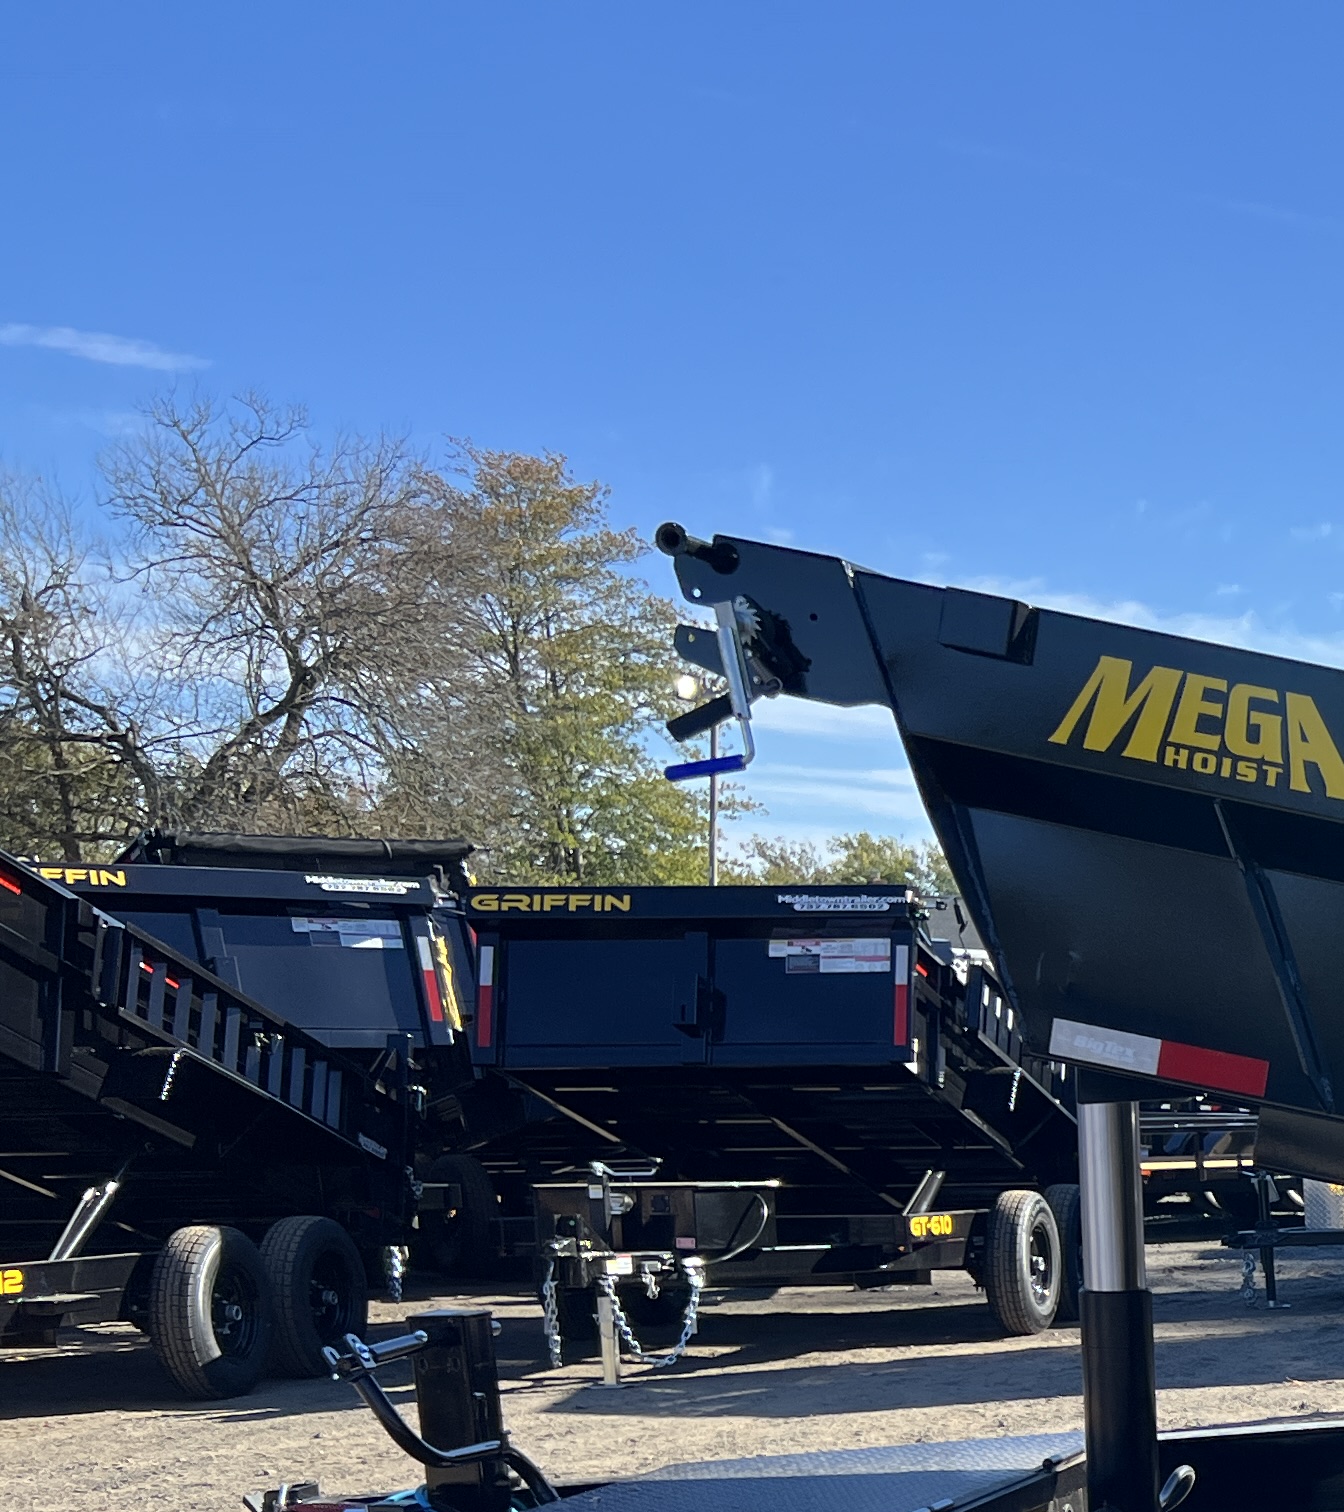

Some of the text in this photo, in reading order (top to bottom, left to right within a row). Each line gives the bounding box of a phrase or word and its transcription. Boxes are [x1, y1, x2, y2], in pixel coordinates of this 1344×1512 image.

[1164, 746, 1284, 787] HOIST
[31, 867, 126, 887] FFIN
[470, 894, 631, 911] GRIFFIN
[910, 1215, 953, 1237] GT-610
